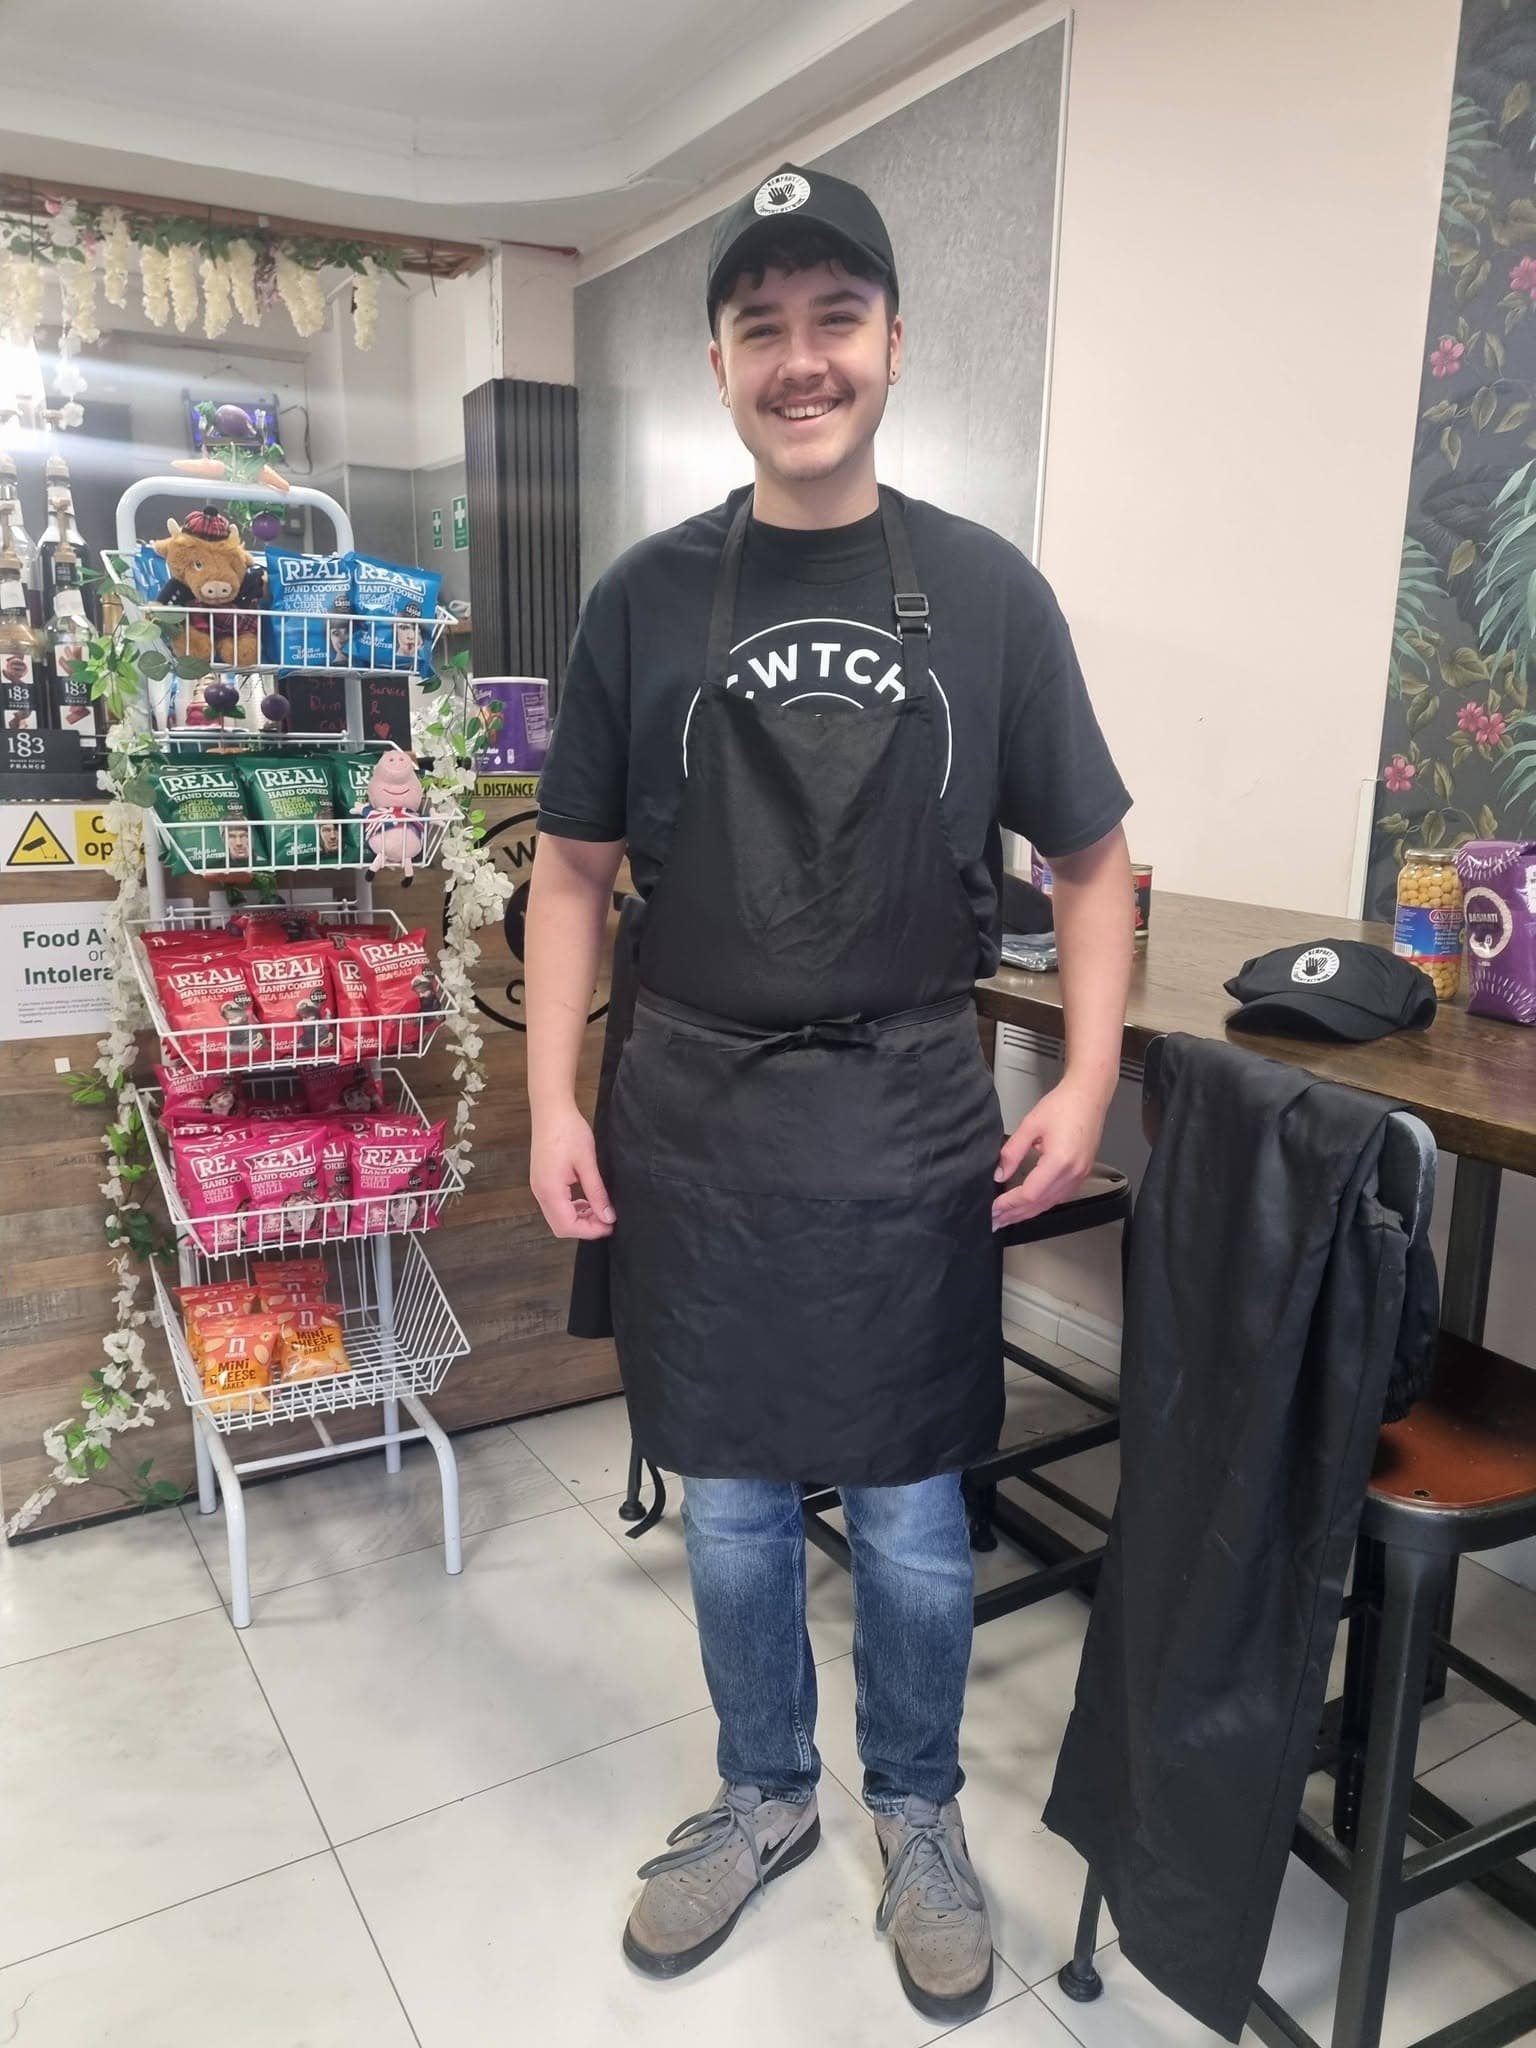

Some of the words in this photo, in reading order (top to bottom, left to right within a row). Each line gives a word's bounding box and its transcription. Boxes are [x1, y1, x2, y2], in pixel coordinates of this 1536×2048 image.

[284, 558, 346, 581] REAL
[359, 564, 422, 591] REAL
[284, 585, 309, 594] HAND
[311, 584, 350, 593] COOKED
[359, 585, 387, 593] HAND
[389, 586, 424, 604] COOKED
[726, 642, 906, 703] WTCH
[165, 773, 234, 792] REAL
[262, 768, 324, 787] REAL
[174, 792, 202, 804] HAND
[203, 791, 240, 799] COOKED
[267, 789, 295, 799] HAND
[296, 787, 329, 796] COOKED
[483, 783, 534, 796] DISTANCE
[23, 929, 80, 948] Food
[88, 949, 107, 961] or
[365, 942, 425, 963] REAL
[25, 965, 114, 985] Intolera
[175, 968, 242, 988] REAL
[257, 957, 321, 982] REAL
[374, 963, 399, 974] HAND
[180, 988, 208, 998] HAND
[209, 984, 247, 995] COOKED
[258, 983, 286, 994] HAND
[287, 980, 323, 991] COOKED
[279, 990, 301, 1000] SALT
[197, 1155, 238, 1178] REA
[253, 1145, 312, 1170] REAL
[365, 1148, 422, 1167] REAL
[202, 1178, 229, 1190] HAND
[251, 1173, 277, 1183] HAND
[280, 1167, 316, 1179] COOKED
